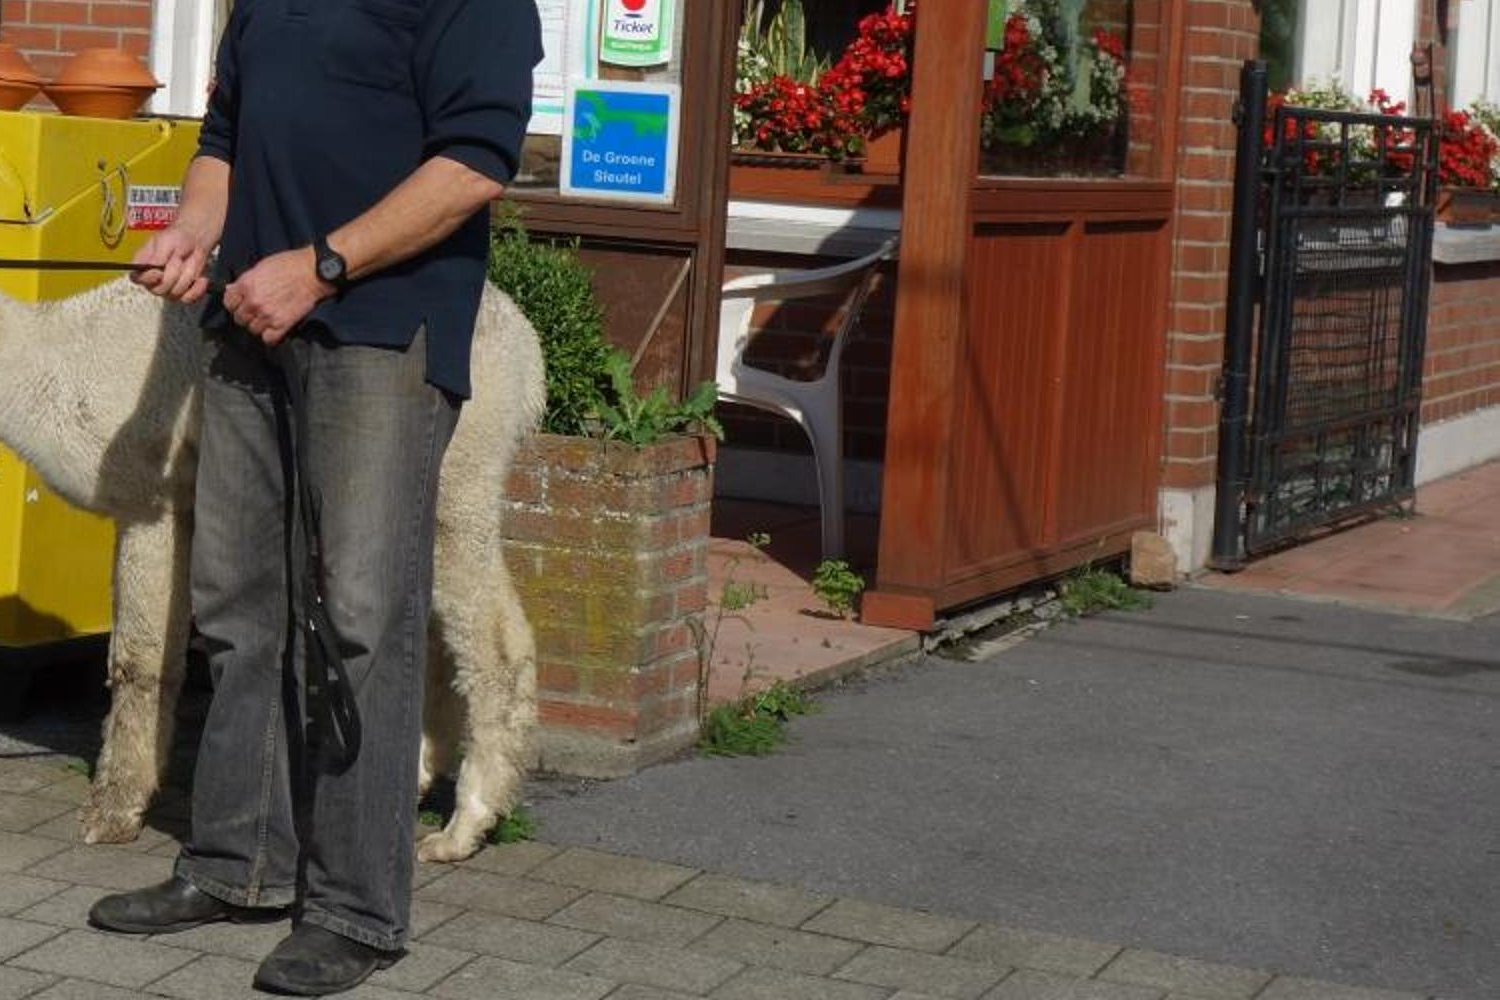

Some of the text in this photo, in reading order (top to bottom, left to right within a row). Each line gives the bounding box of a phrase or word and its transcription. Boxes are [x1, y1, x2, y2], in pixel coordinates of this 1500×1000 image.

[613, 19, 654, 34] Ticket
[582, 150, 656, 167] De Groene
[594, 170, 642, 185] Sleutel
